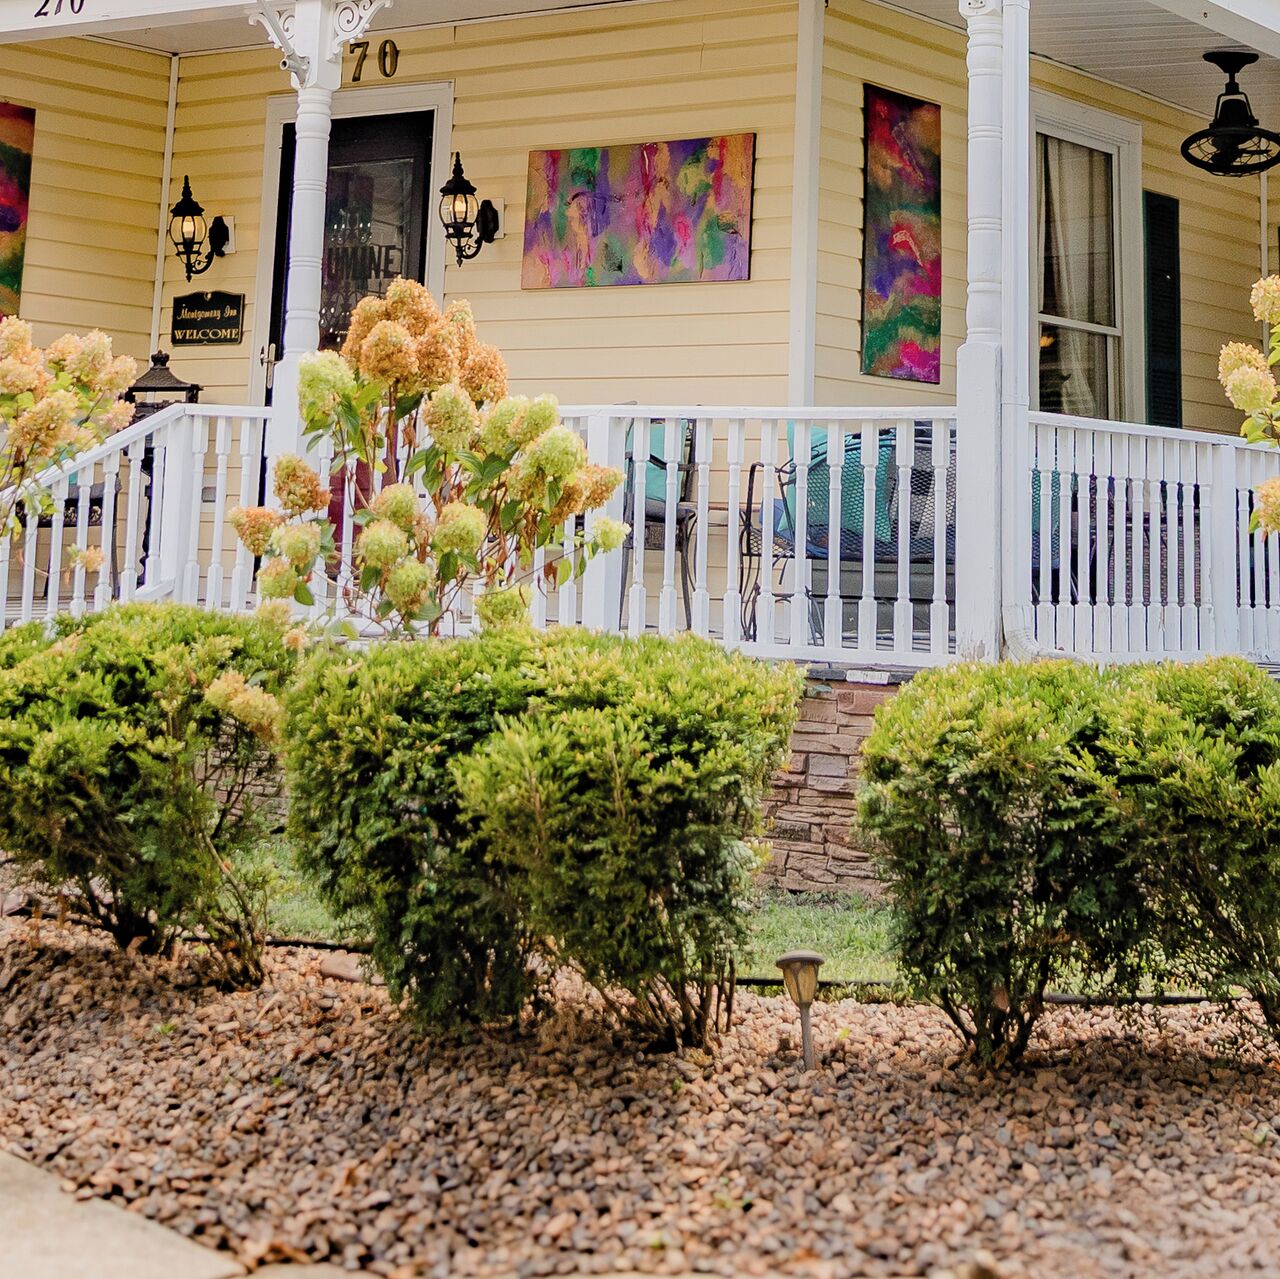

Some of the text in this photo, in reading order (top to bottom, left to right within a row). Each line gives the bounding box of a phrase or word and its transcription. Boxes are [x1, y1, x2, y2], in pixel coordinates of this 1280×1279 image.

[349, 40, 400, 82] 70
[177, 304, 238, 320] Montgomery Inn
[174, 328, 239, 340] WELCOME
